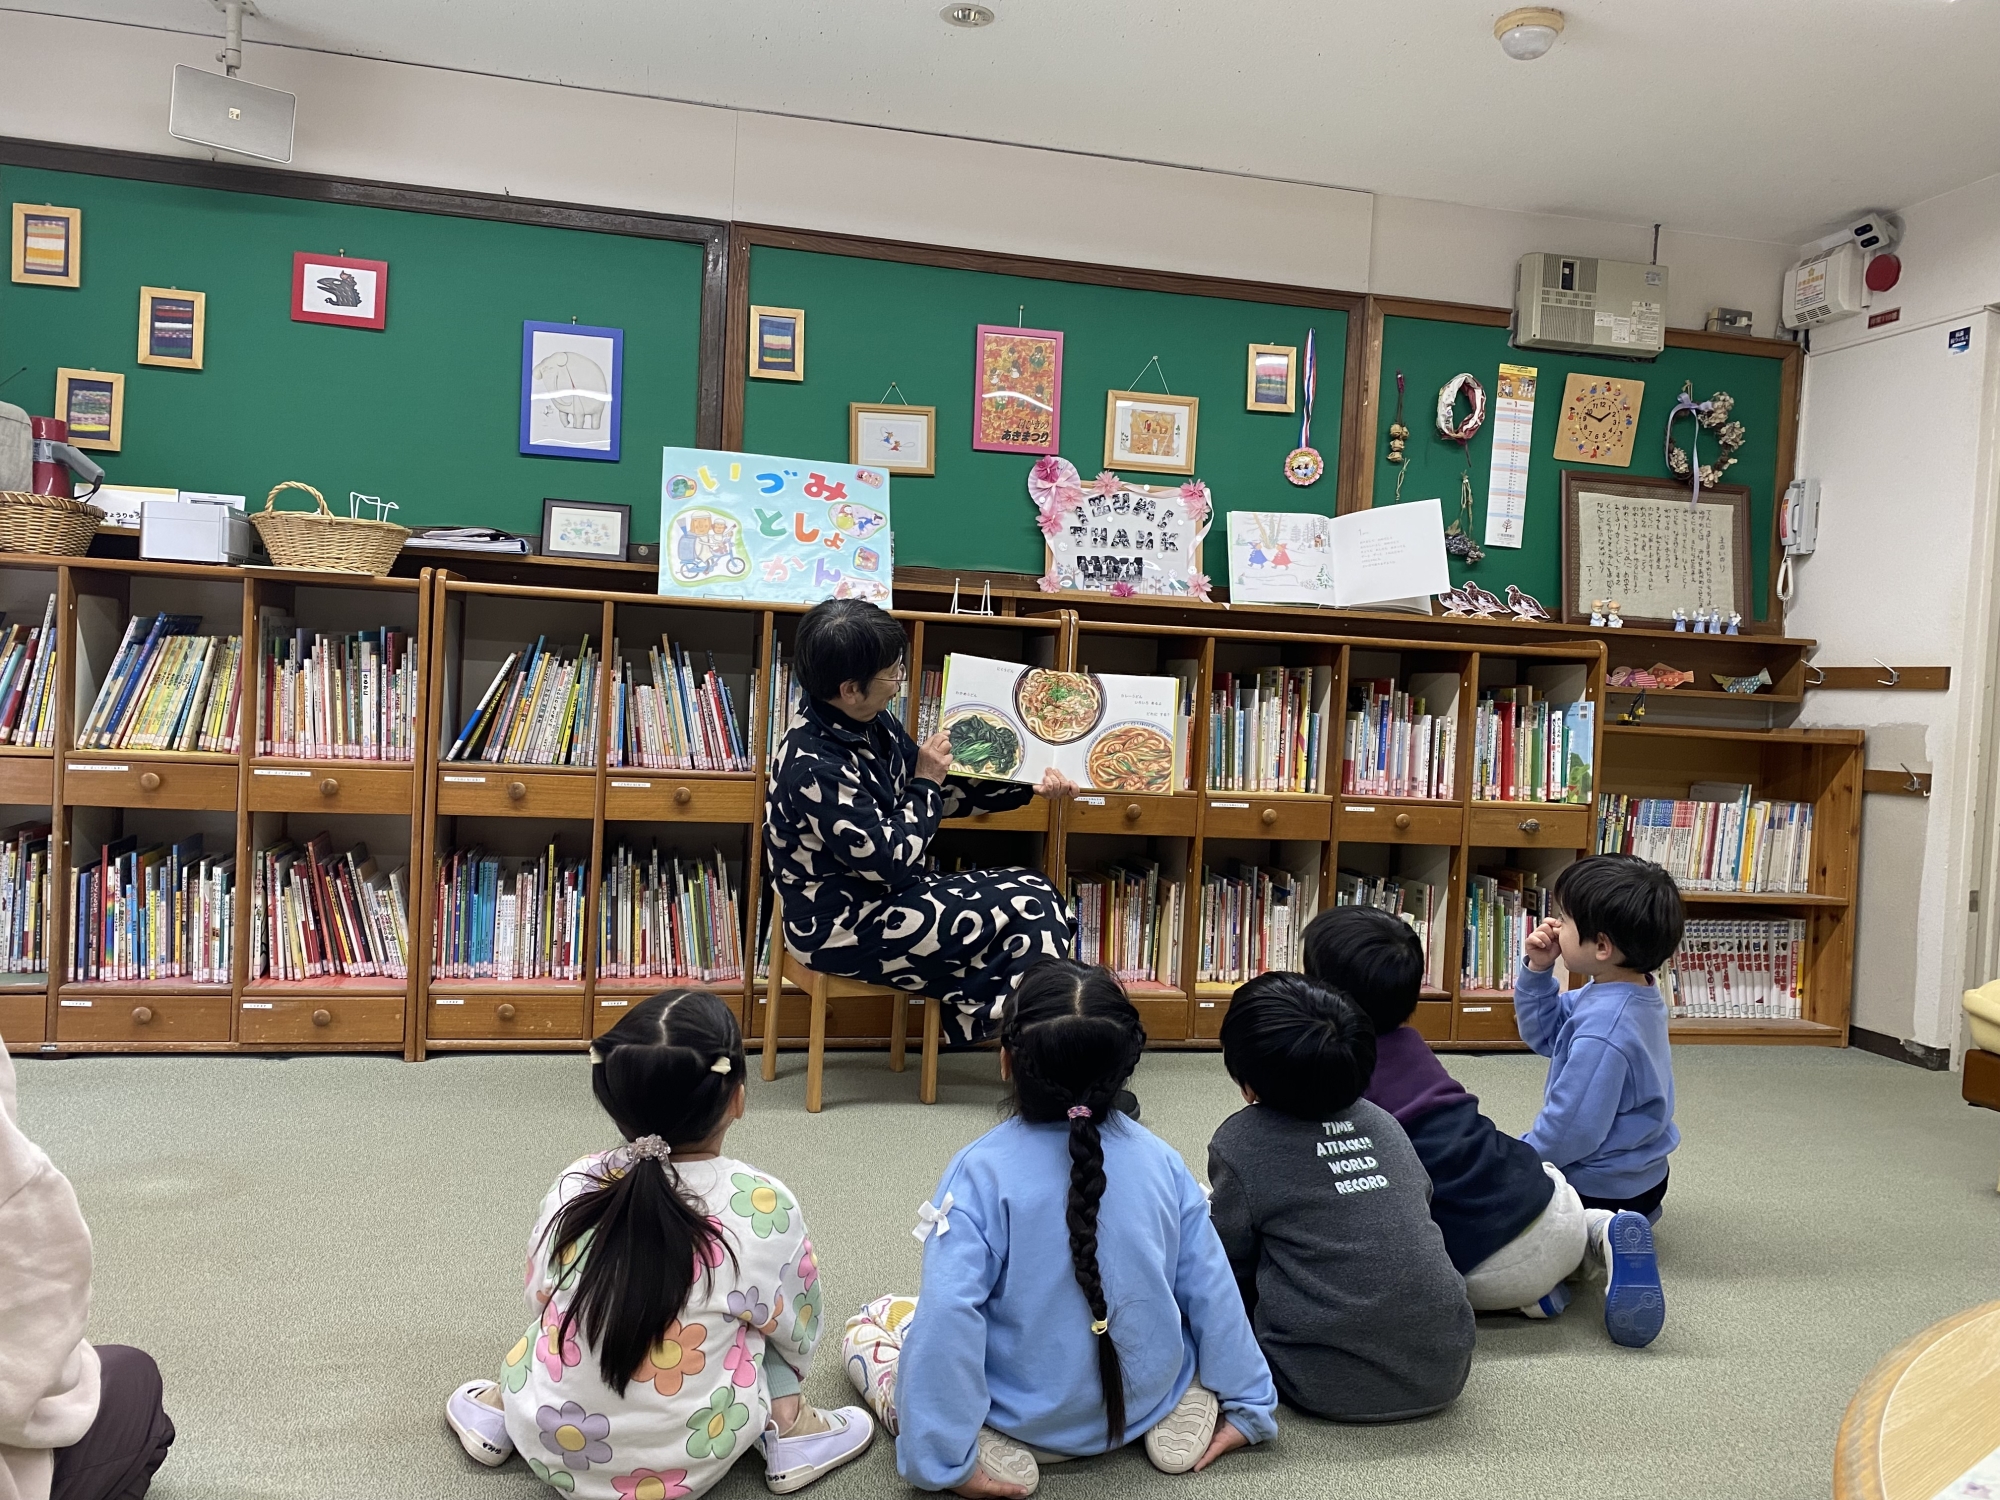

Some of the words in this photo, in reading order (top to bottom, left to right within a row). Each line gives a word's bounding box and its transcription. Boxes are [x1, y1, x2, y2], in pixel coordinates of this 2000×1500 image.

[1001, 429, 1049, 443] あきまつり
[698, 462, 849, 502] いづみ
[1075, 493, 1174, 530] IZUMI
[753, 508, 846, 551] としょ
[1069, 526, 1179, 551] THANK
[763, 555, 842, 587] かん
[1322, 1121, 1356, 1136] TIME
[1316, 1137, 1374, 1157] ATTACK!!
[1328, 1157, 1379, 1175] WORLD
[1334, 1175, 1390, 1195] RECORD
